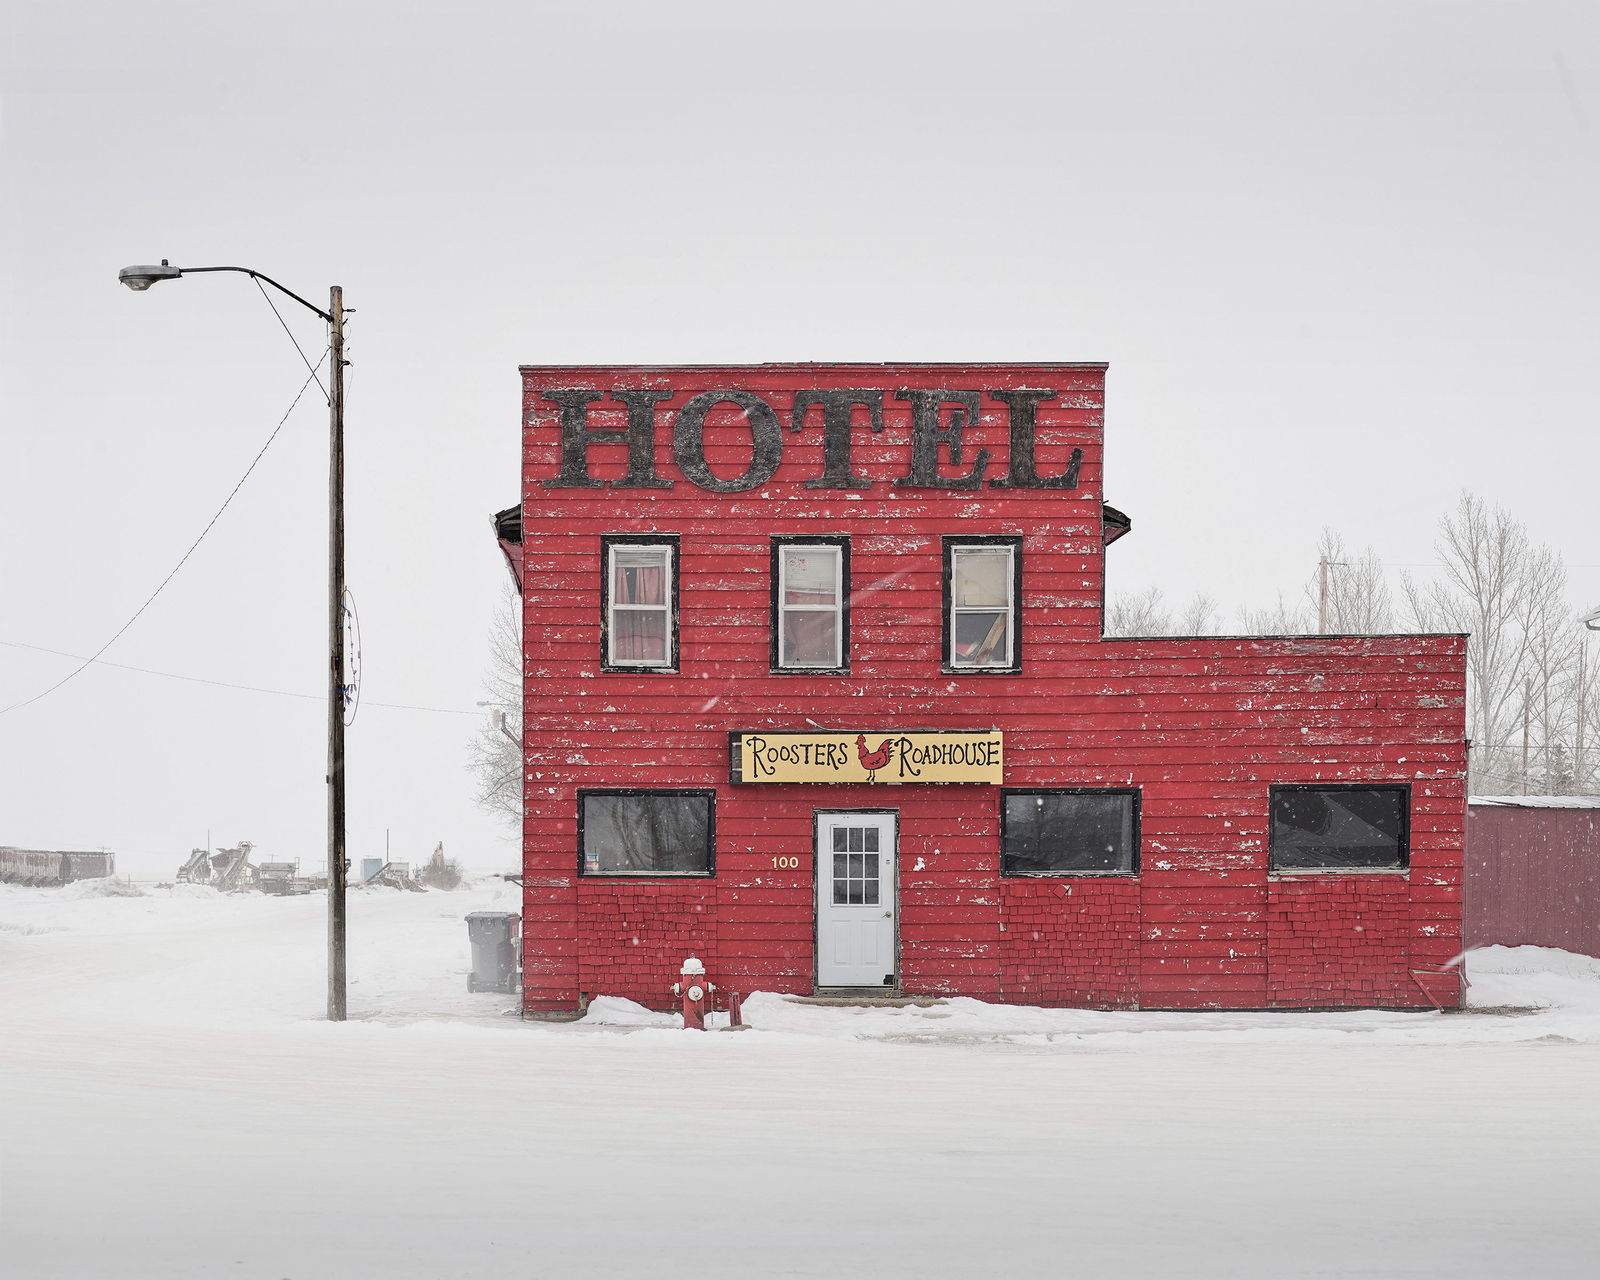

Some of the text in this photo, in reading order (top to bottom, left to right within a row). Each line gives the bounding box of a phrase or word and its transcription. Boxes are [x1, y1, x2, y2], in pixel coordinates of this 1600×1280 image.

[541, 388, 1084, 493] HOTEL
[747, 736, 1000, 778] ROOSTERS ROADHOUSE
[771, 856, 799, 868] 100
